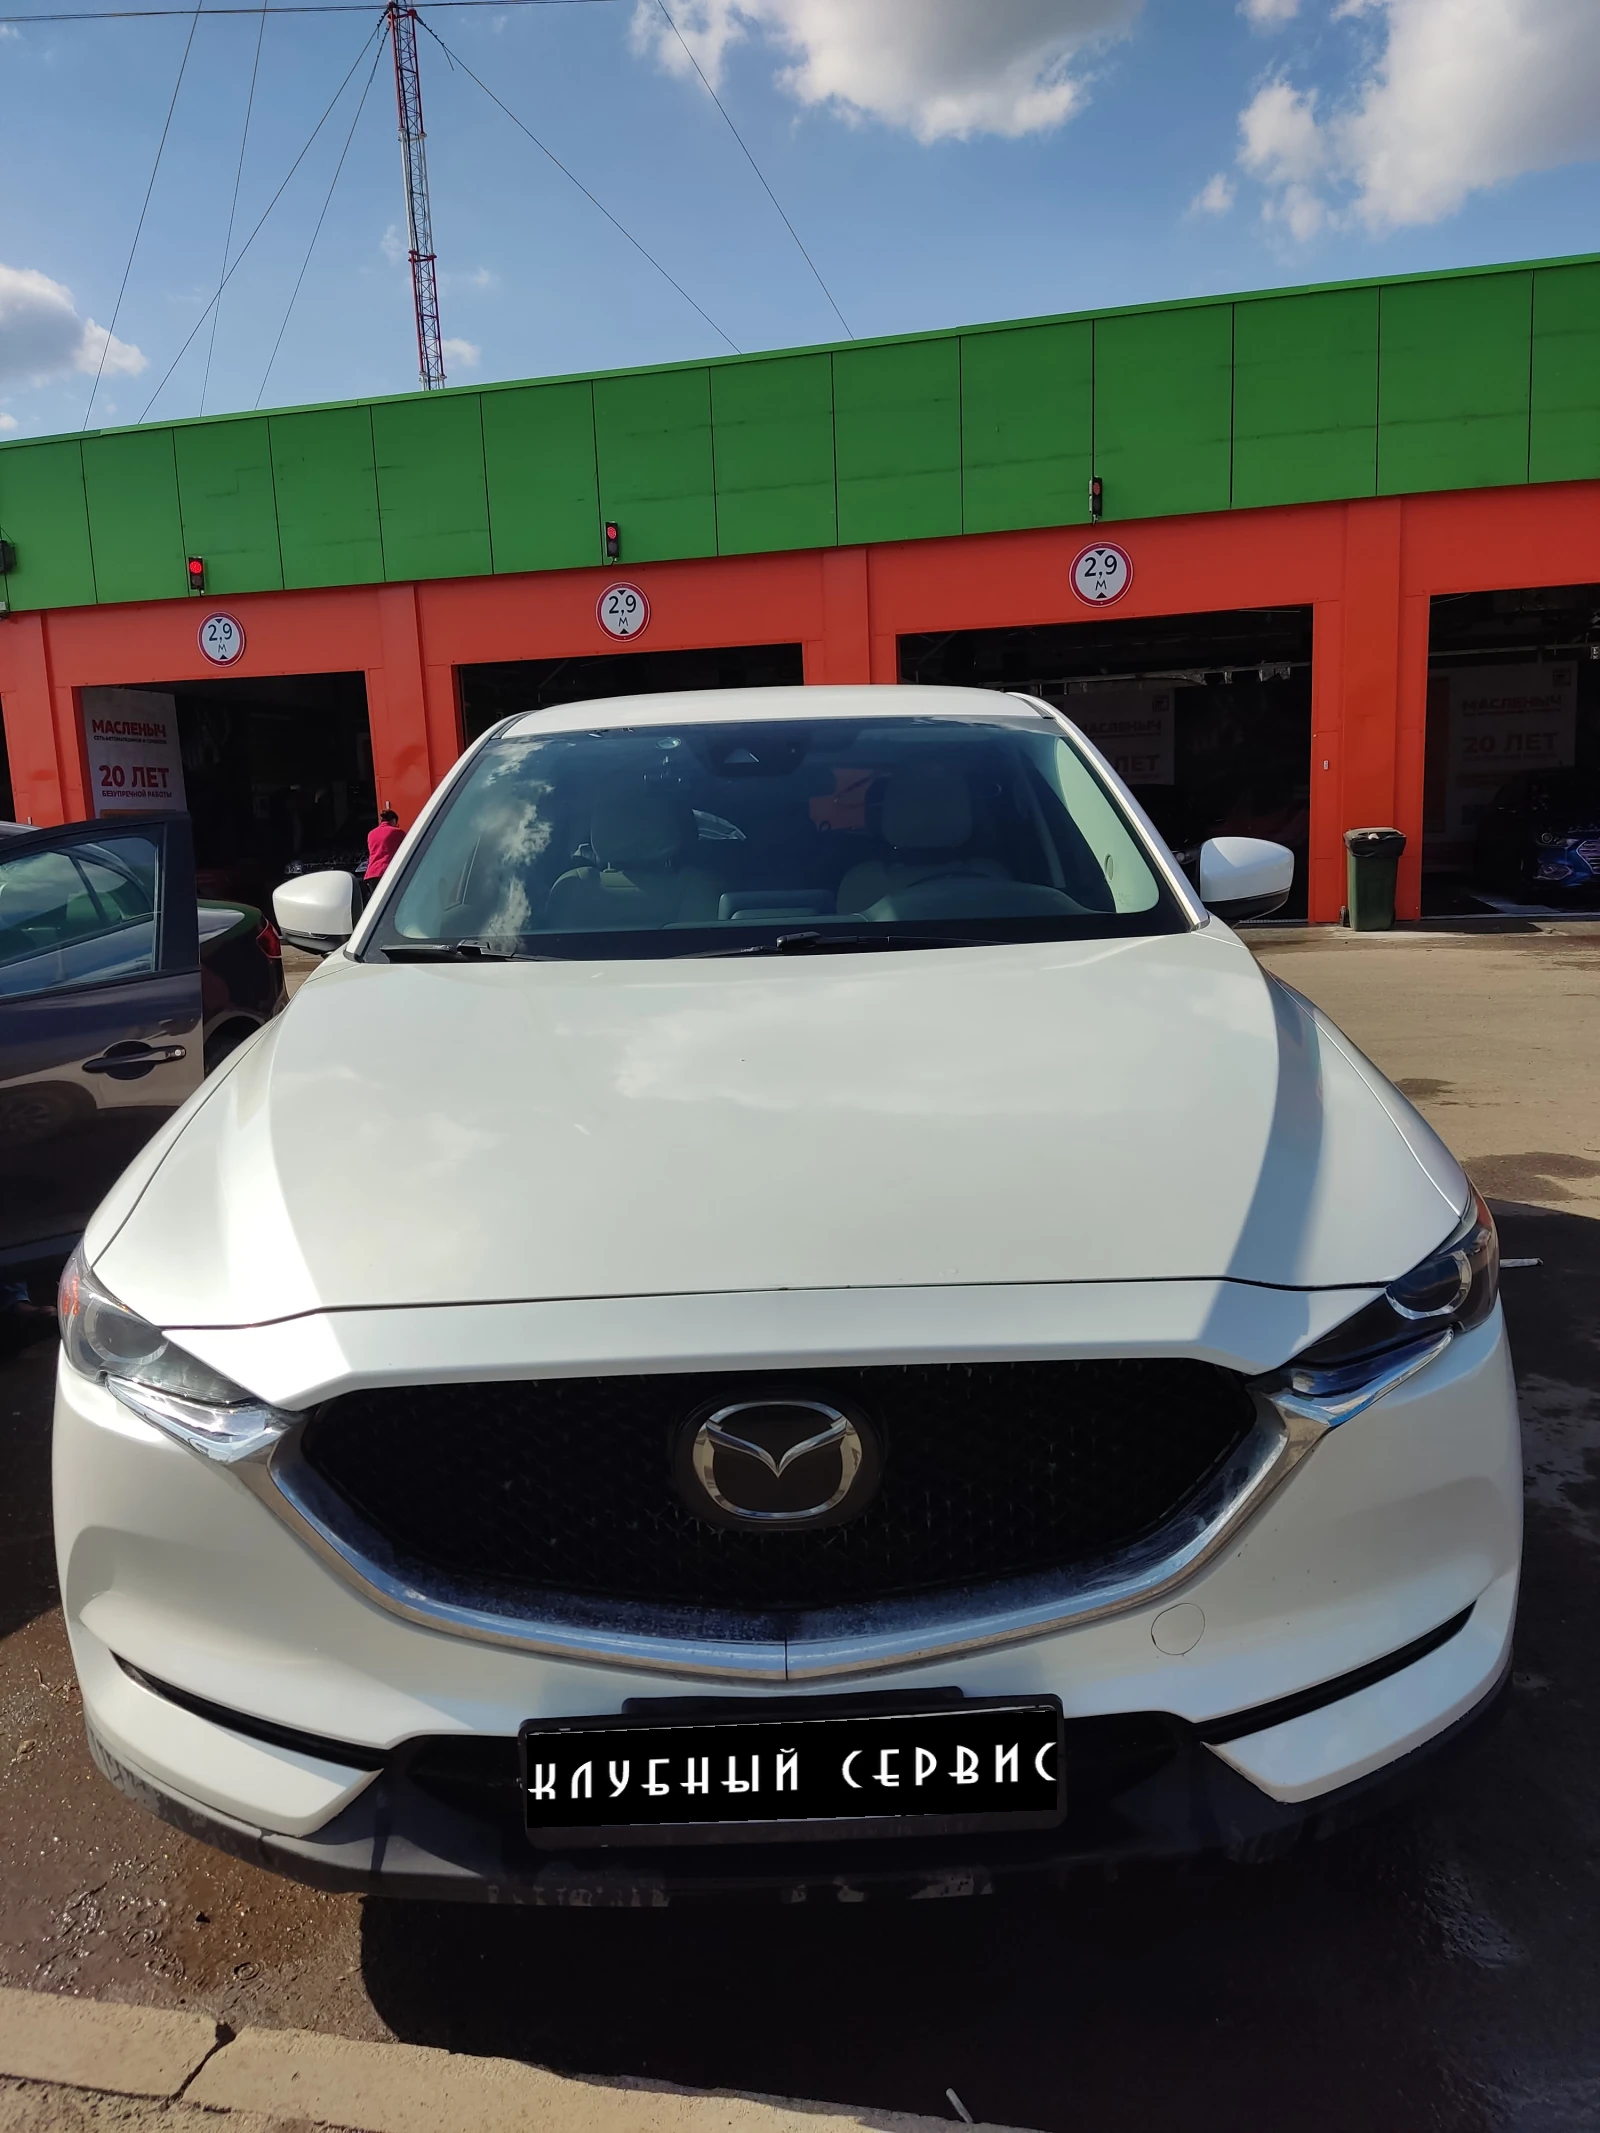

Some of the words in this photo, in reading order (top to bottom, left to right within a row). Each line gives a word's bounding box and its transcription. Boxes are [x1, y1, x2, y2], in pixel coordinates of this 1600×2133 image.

[1084, 554, 1118, 579] 2,9
[608, 594, 637, 616] 2,9
[207, 622, 233, 643] 2,9
[1462, 694, 1562, 711] МАСЛЕНЫЧ
[92, 719, 167, 738] МАСЛЕНЫЧ
[1462, 735, 1496, 754] 20
[1503, 732, 1559, 752] ЛЕТ
[98, 764, 126, 788] 20
[131, 766, 169, 788] ЛЕТ
[102, 789, 147, 797] БЕЗУПРЕЧНОЙ
